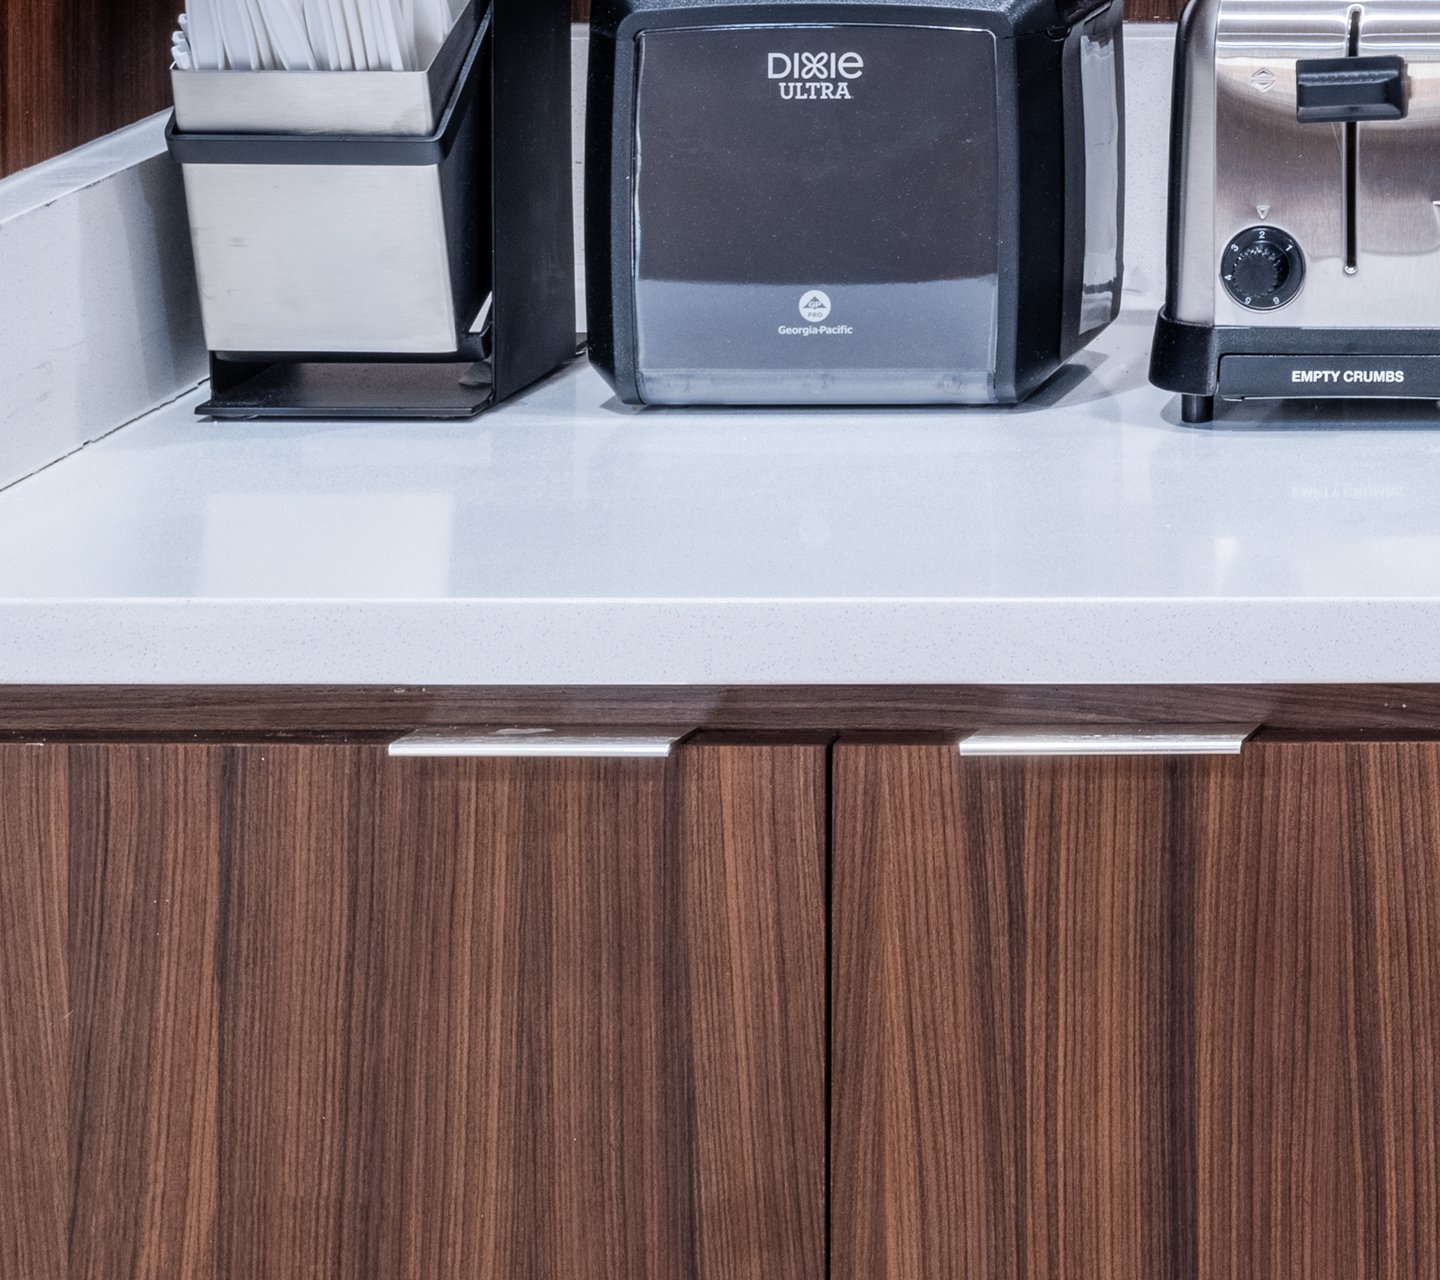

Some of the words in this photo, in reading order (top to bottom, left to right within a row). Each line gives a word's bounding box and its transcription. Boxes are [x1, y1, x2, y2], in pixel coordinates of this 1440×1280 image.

[779, 82, 852, 99] ULTRA
[1258, 231, 1265, 239] 2
[1231, 244, 1239, 252] 3
[1285, 244, 1293, 252] 1
[1244, 296, 1252, 305] 5
[1272, 296, 1280, 305] 6
[777, 325, 853, 337] Georgia-Pacific
[1291, 370, 1341, 382] EMPTY
[1343, 370, 1404, 383] CRUMBS
